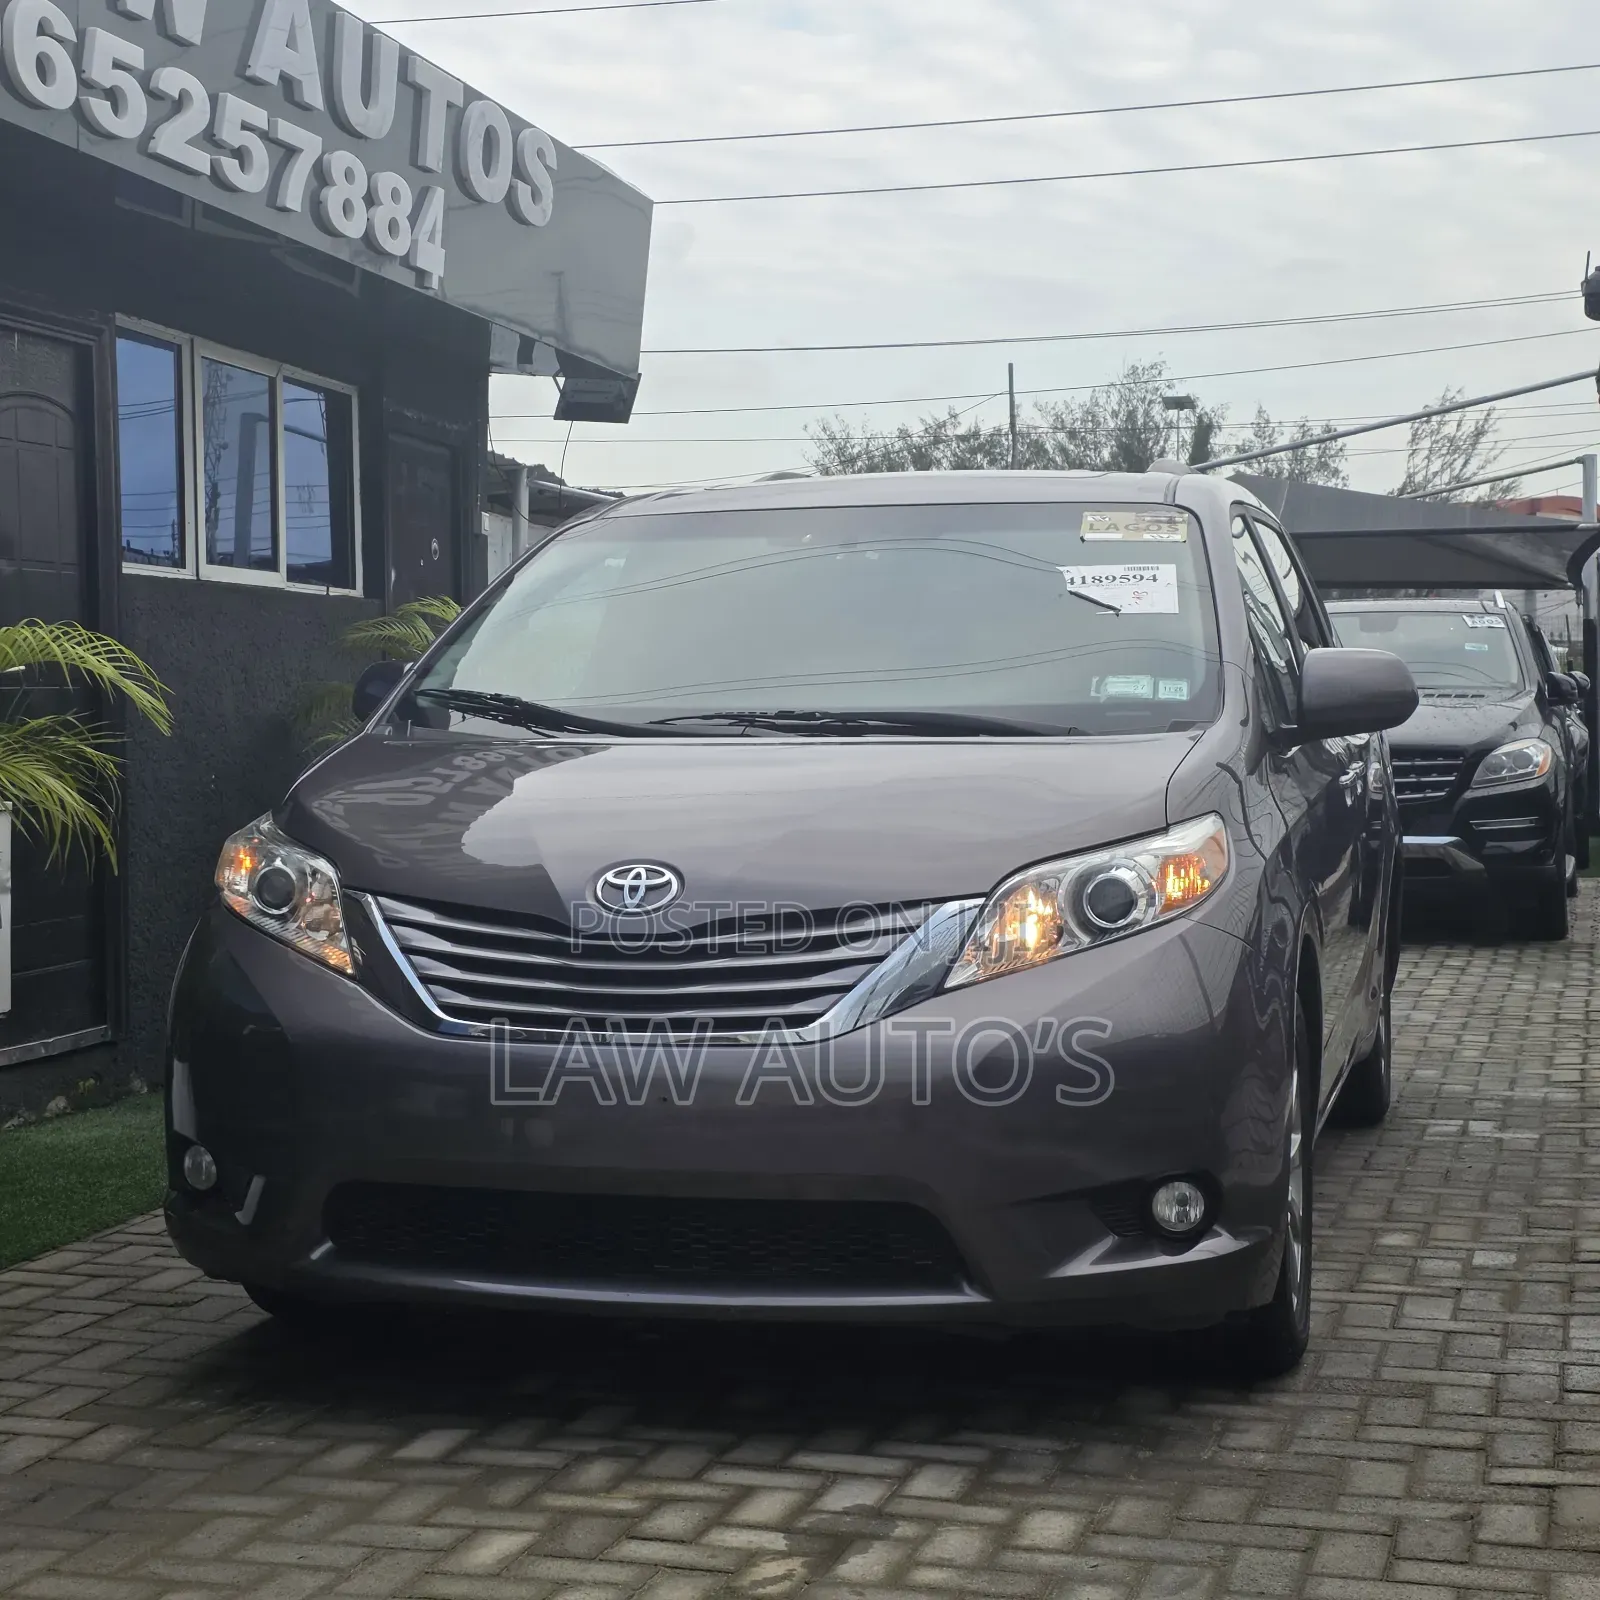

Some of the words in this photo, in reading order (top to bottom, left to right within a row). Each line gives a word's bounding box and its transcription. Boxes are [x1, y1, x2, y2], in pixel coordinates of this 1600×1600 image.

[2, 0, 446, 289] 65257884
[245, 0, 557, 227] AUTOS
[1066, 573, 1159, 586] 4189594
[1088, 522, 1180, 533] LAGOS
